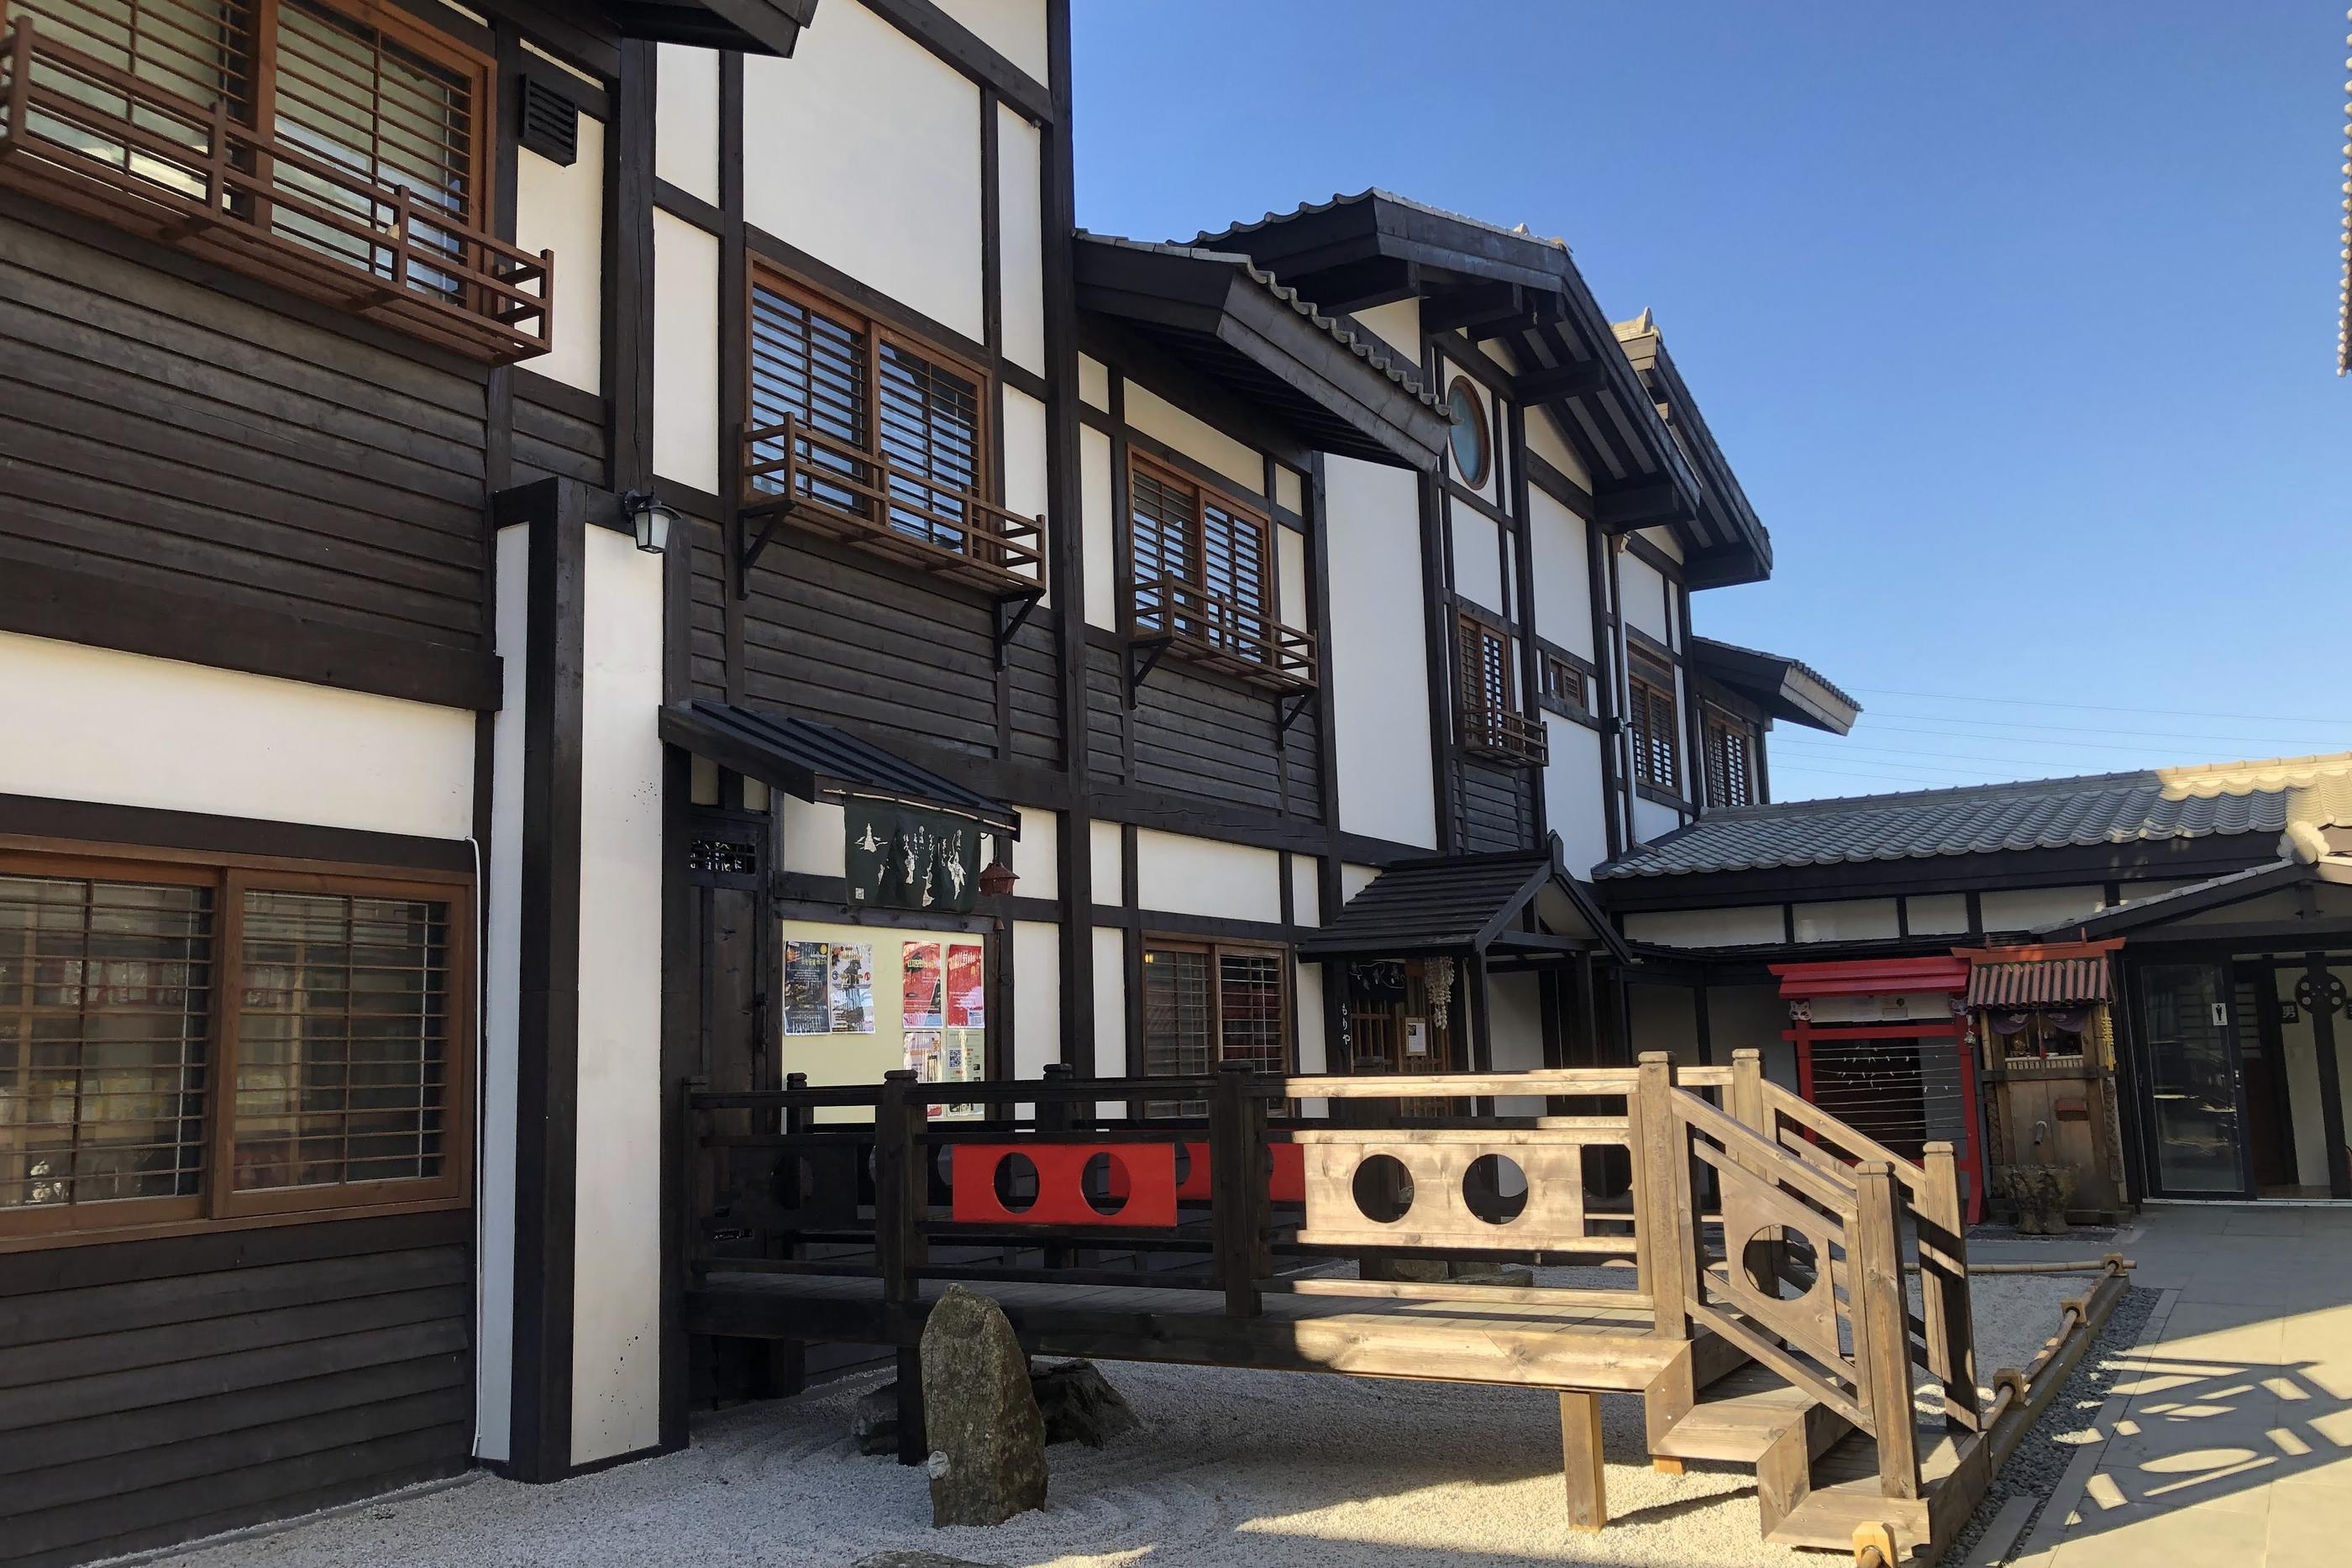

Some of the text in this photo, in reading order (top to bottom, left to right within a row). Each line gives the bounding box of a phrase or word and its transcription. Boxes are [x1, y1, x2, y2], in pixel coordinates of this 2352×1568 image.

[1342, 1003, 1351, 1046] もりや
[2282, 1005, 2296, 1019] 男
